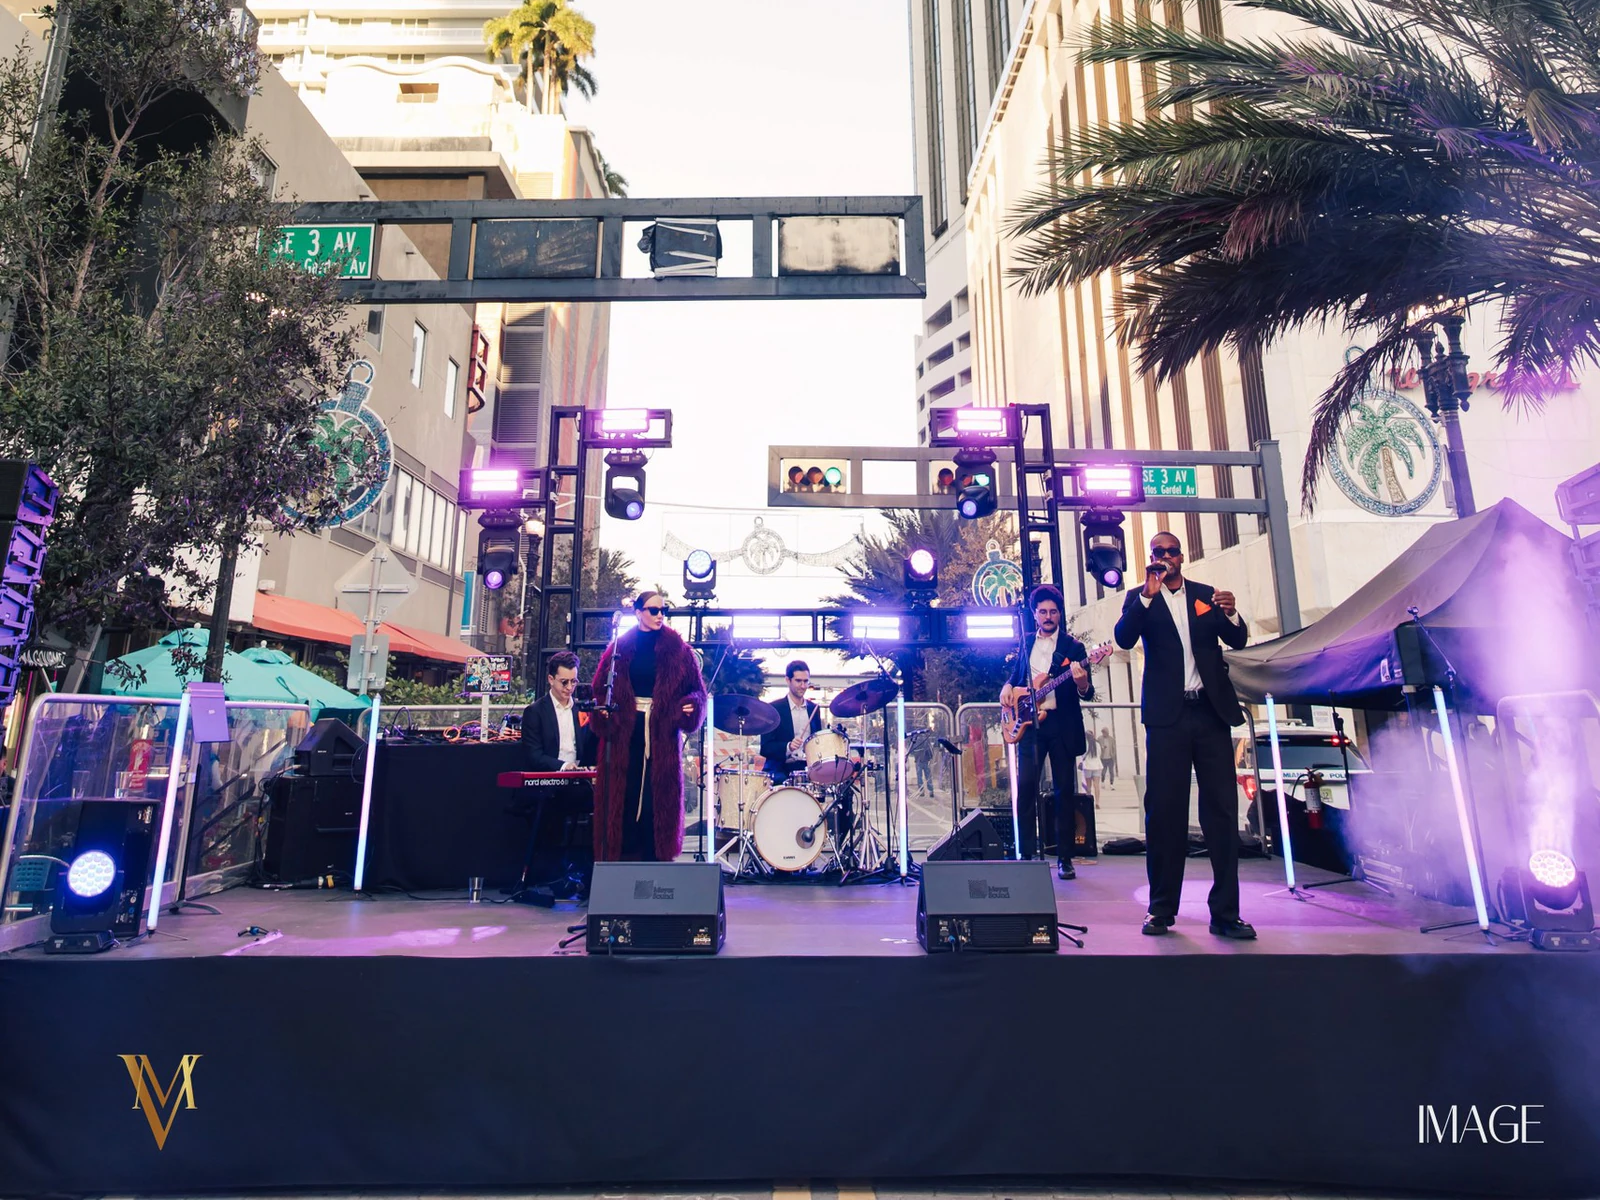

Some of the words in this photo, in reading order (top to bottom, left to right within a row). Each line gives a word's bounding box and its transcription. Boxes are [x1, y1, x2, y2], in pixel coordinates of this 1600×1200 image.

[307, 229, 320, 256] 3
[333, 231, 356, 254] AV
[349, 259, 366, 274] Av
[1142, 469, 1155, 483] SE
[1160, 468, 1169, 485] 3
[1175, 470, 1187, 483] AV
[1160, 484, 1182, 495] Gardel
[1185, 484, 1195, 495] Av
[524, 778, 540, 786] nord
